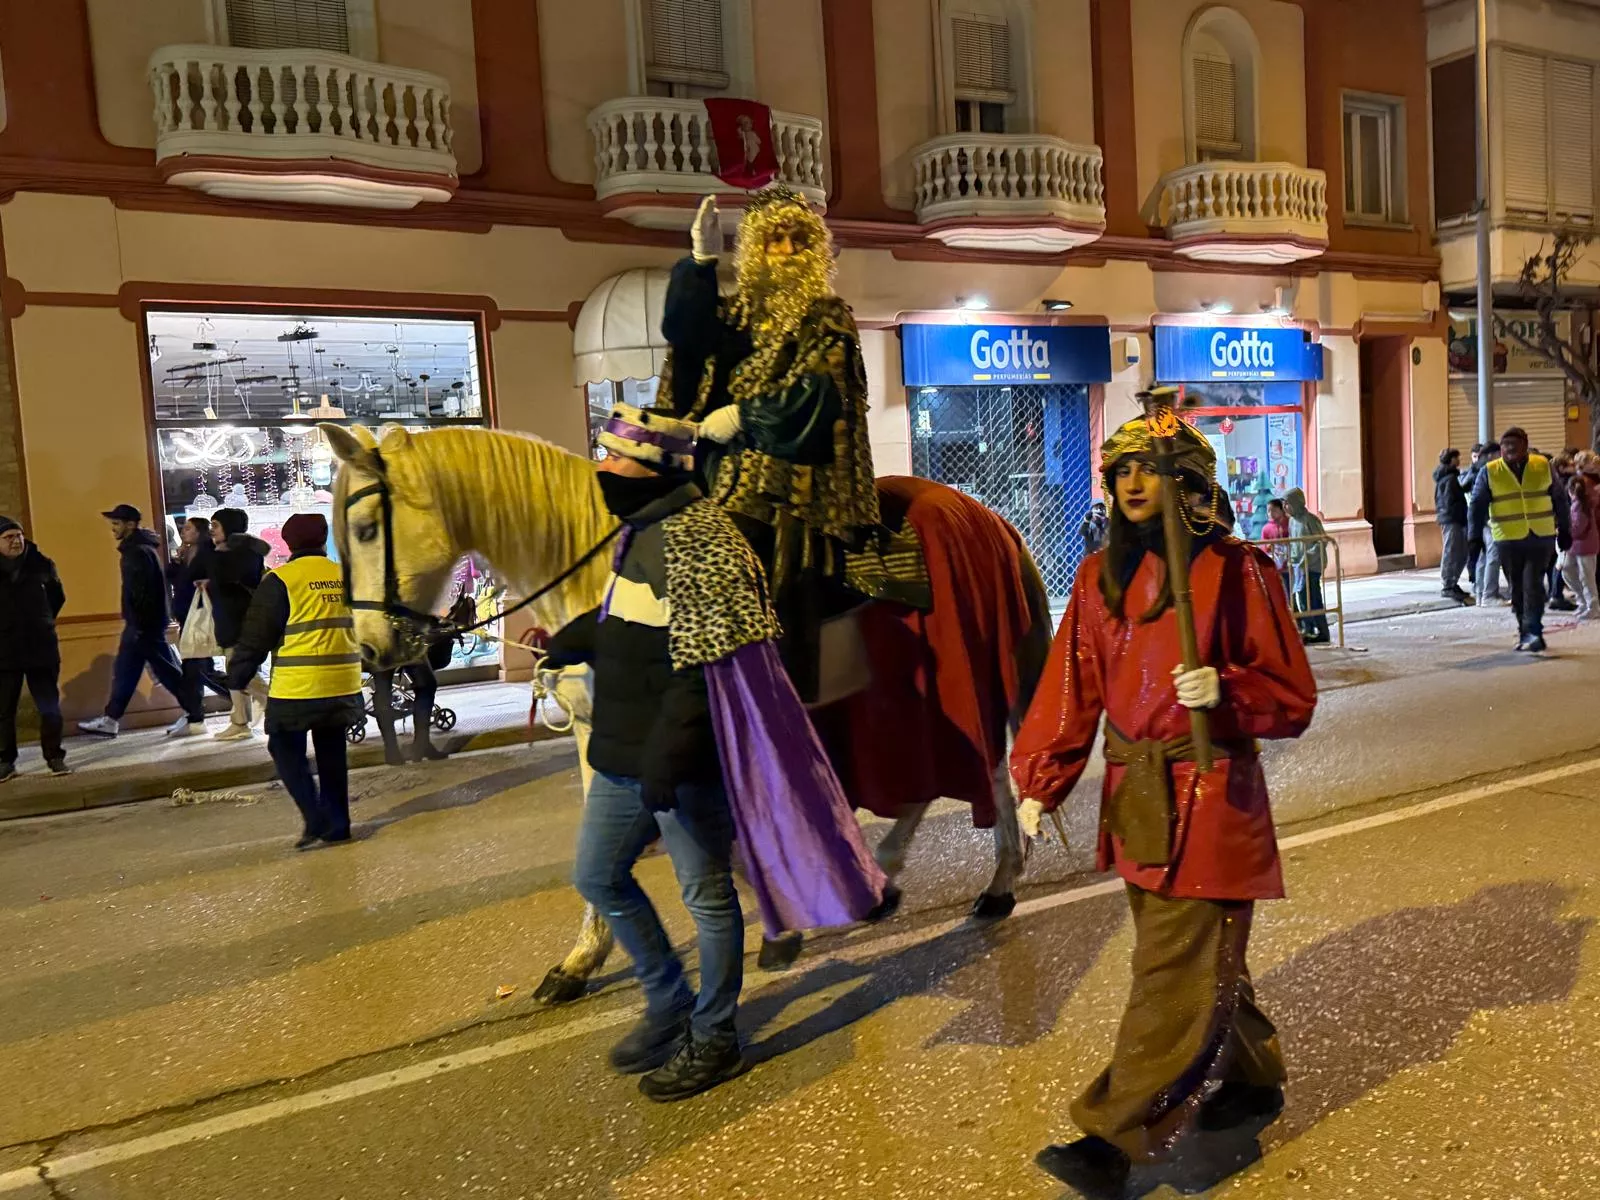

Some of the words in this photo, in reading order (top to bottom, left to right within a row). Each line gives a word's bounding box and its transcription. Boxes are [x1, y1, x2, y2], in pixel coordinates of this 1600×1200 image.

[970, 328, 1050, 370] Gotta
[1210, 330, 1275, 368] Gotta
[993, 372, 1032, 380] PERFUMERÍAS
[321, 593, 343, 604] FIEST
